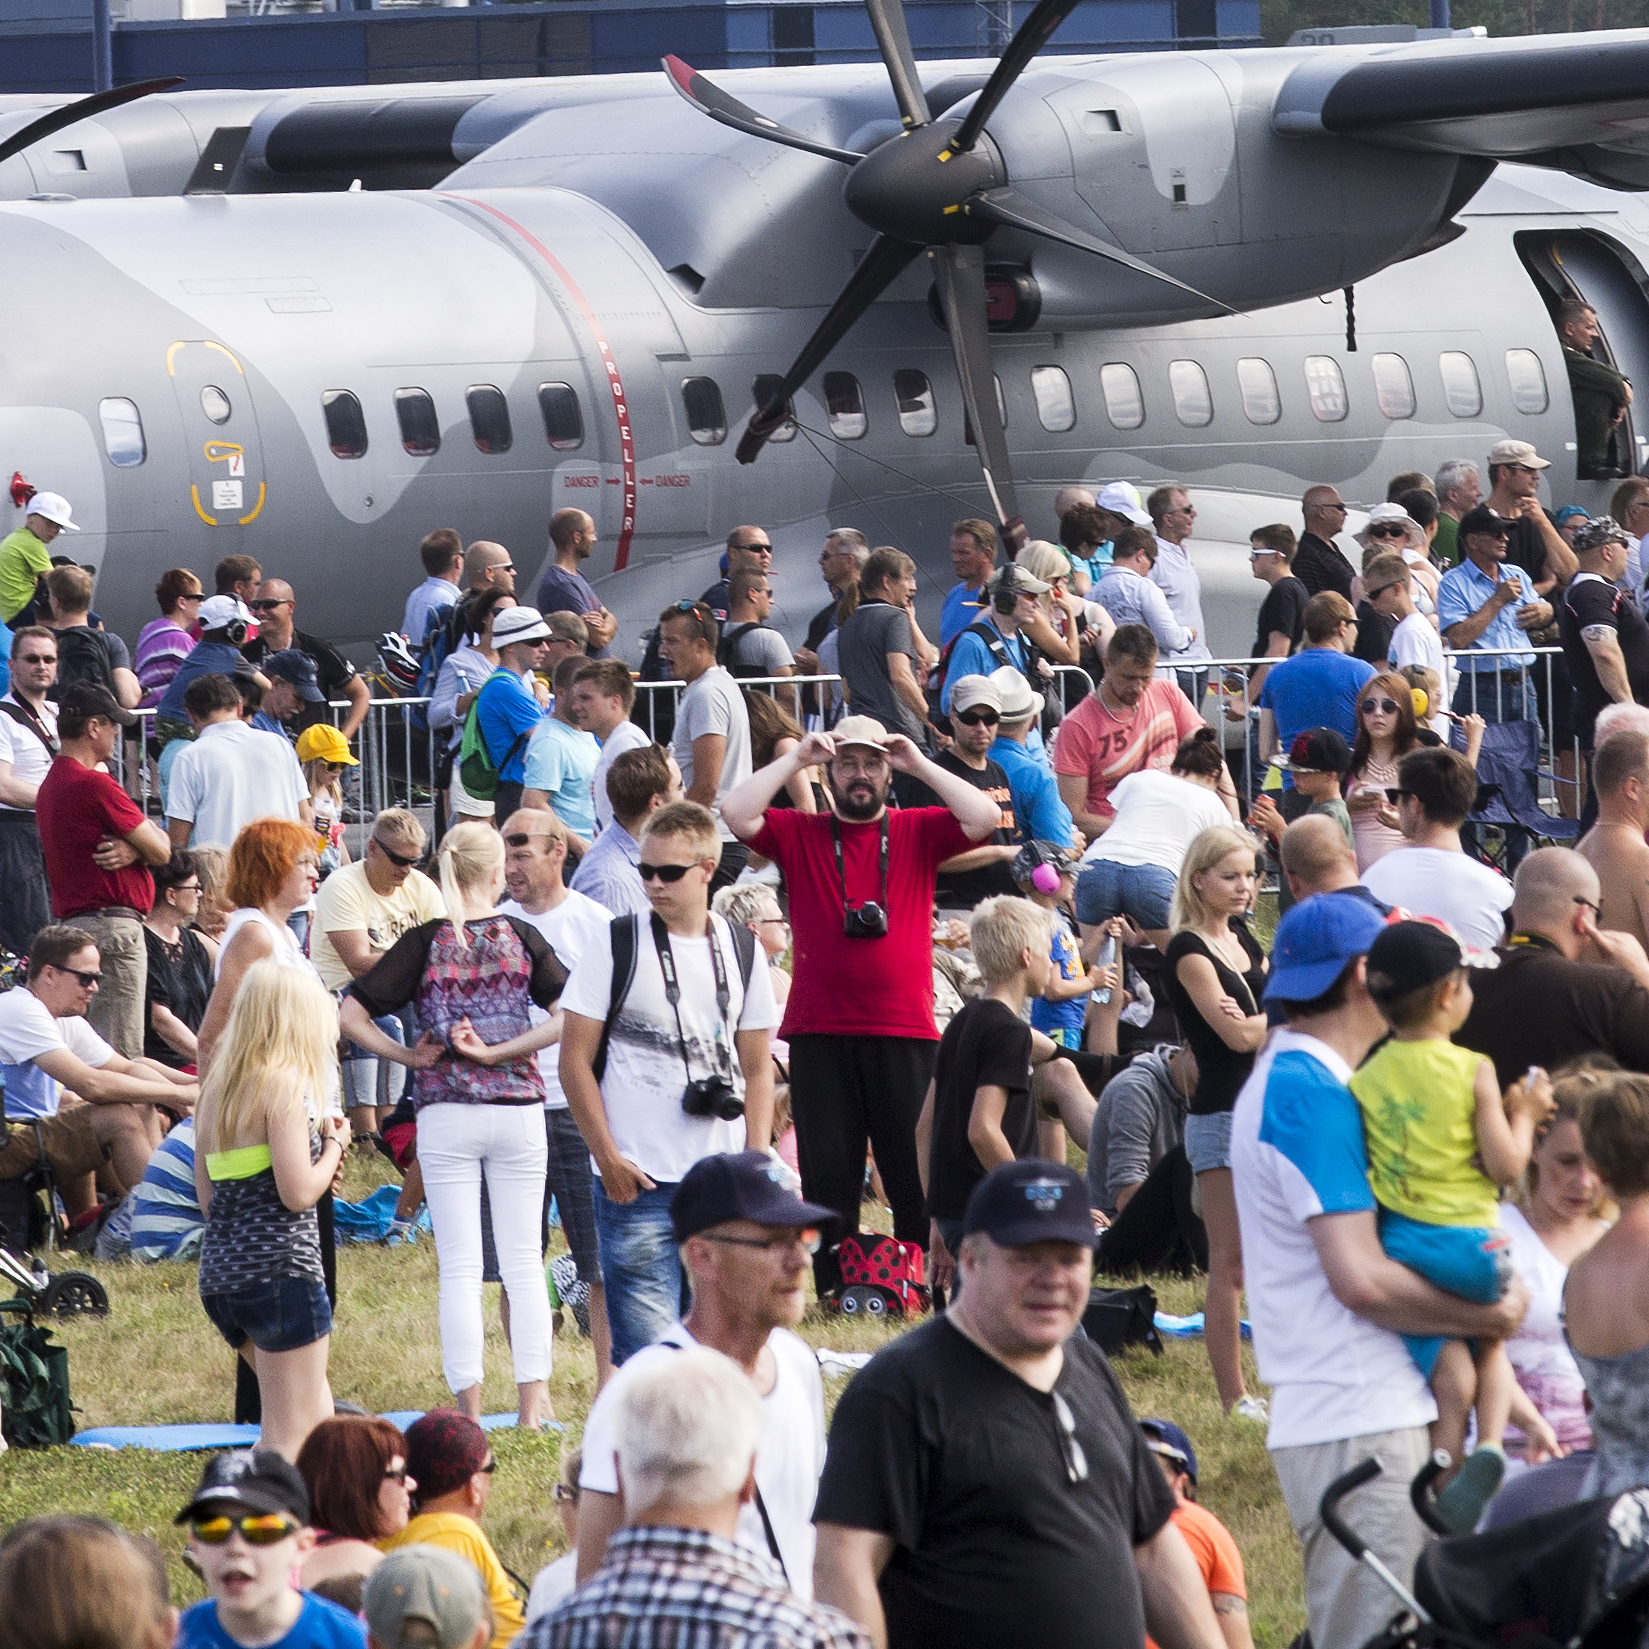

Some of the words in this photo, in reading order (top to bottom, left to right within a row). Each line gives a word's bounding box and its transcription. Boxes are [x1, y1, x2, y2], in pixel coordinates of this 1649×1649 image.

[597, 340, 634, 531] PROPELLER
[564, 475, 599, 488] DANGER
[655, 475, 690, 488] DANGER
